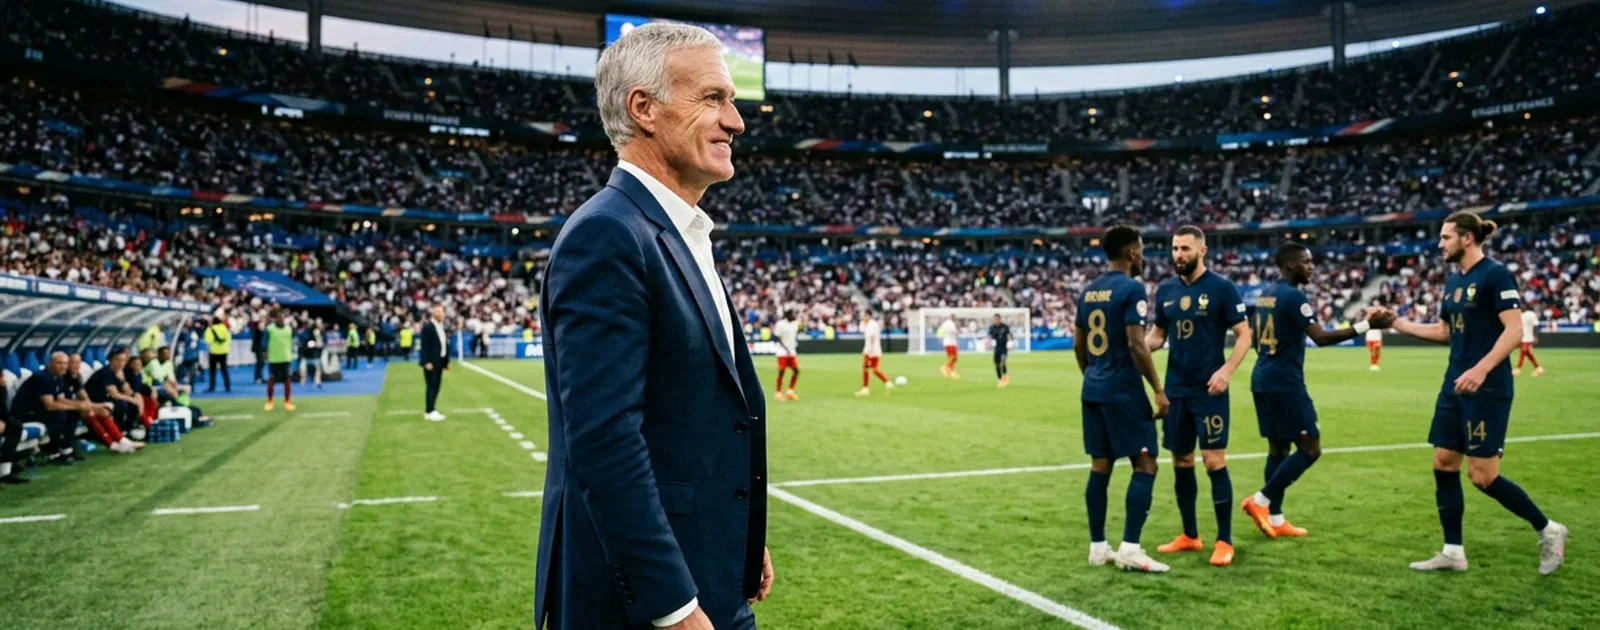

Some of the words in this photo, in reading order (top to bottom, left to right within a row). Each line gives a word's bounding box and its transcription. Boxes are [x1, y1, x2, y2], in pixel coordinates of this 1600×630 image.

[1087, 308, 1109, 356] 8
[1176, 319, 1195, 340] 19
[1256, 312, 1279, 355] 14
[1450, 312, 1465, 334] 14
[1203, 415, 1224, 436] 19
[1466, 420, 1488, 441] 14
